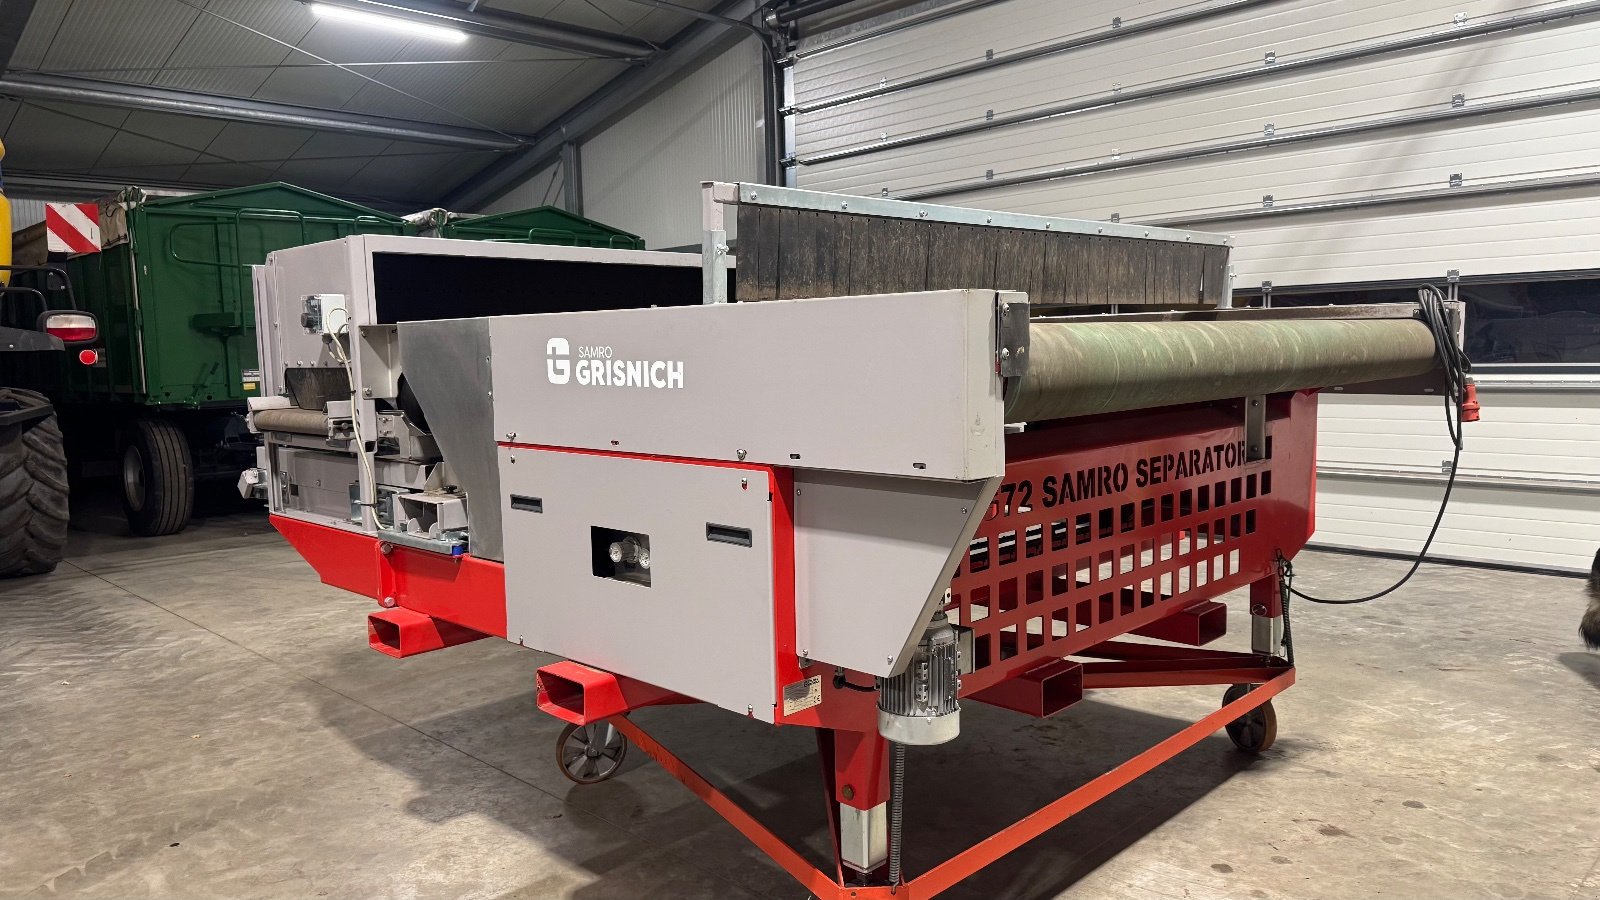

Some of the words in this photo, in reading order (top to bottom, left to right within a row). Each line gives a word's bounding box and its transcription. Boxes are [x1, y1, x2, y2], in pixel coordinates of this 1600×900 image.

[578, 346, 613, 358] SAMRO
[576, 360, 684, 388] GRISNICH
[1042, 463, 1129, 508] SAMRO
